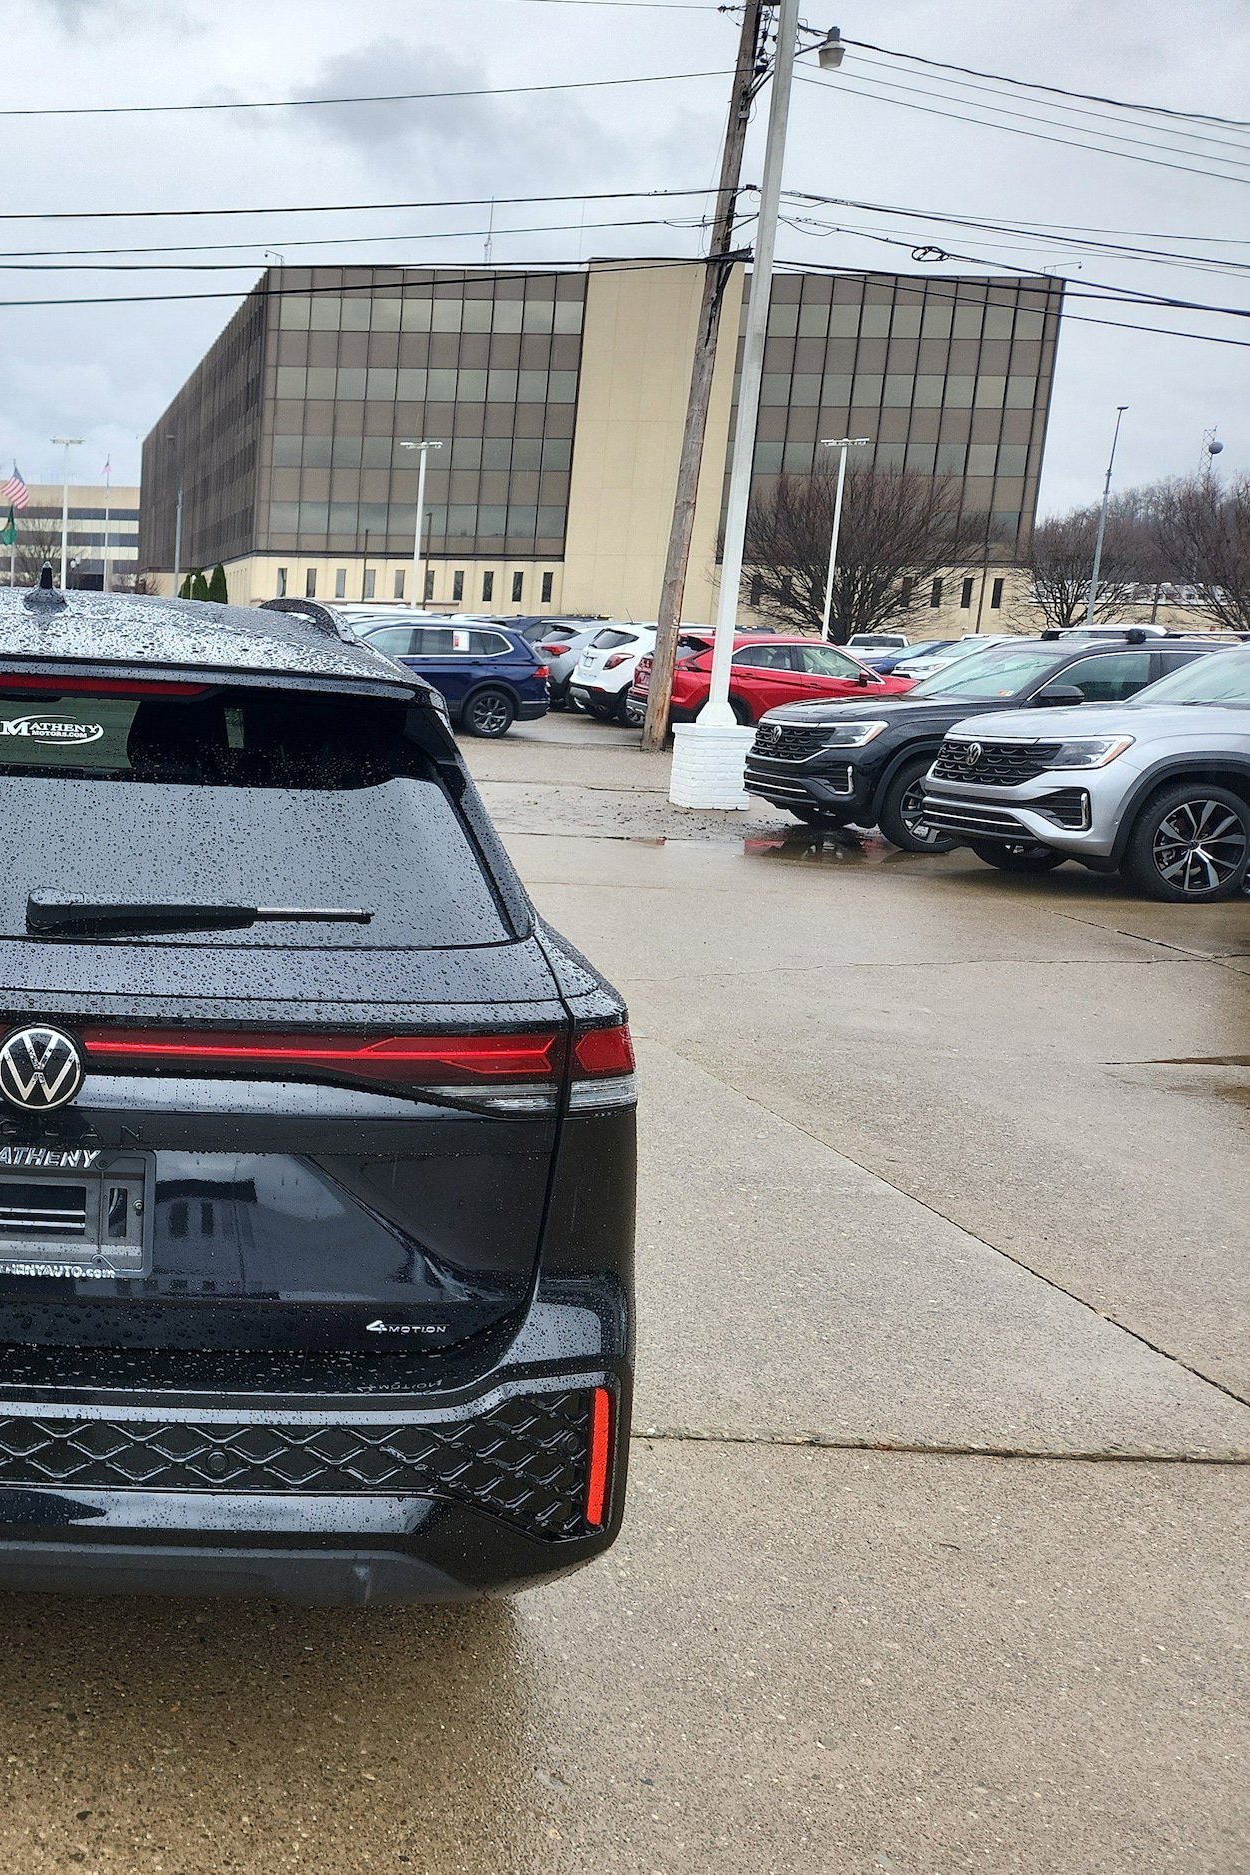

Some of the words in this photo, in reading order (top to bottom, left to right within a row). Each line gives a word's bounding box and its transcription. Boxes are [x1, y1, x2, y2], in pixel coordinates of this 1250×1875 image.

[0, 720, 100, 737] MATHENY
[31, 729, 88, 739] MOTORS.COM
[0, 1029, 79, 1107] VW
[365, 1319, 447, 1335] 4MOTION
